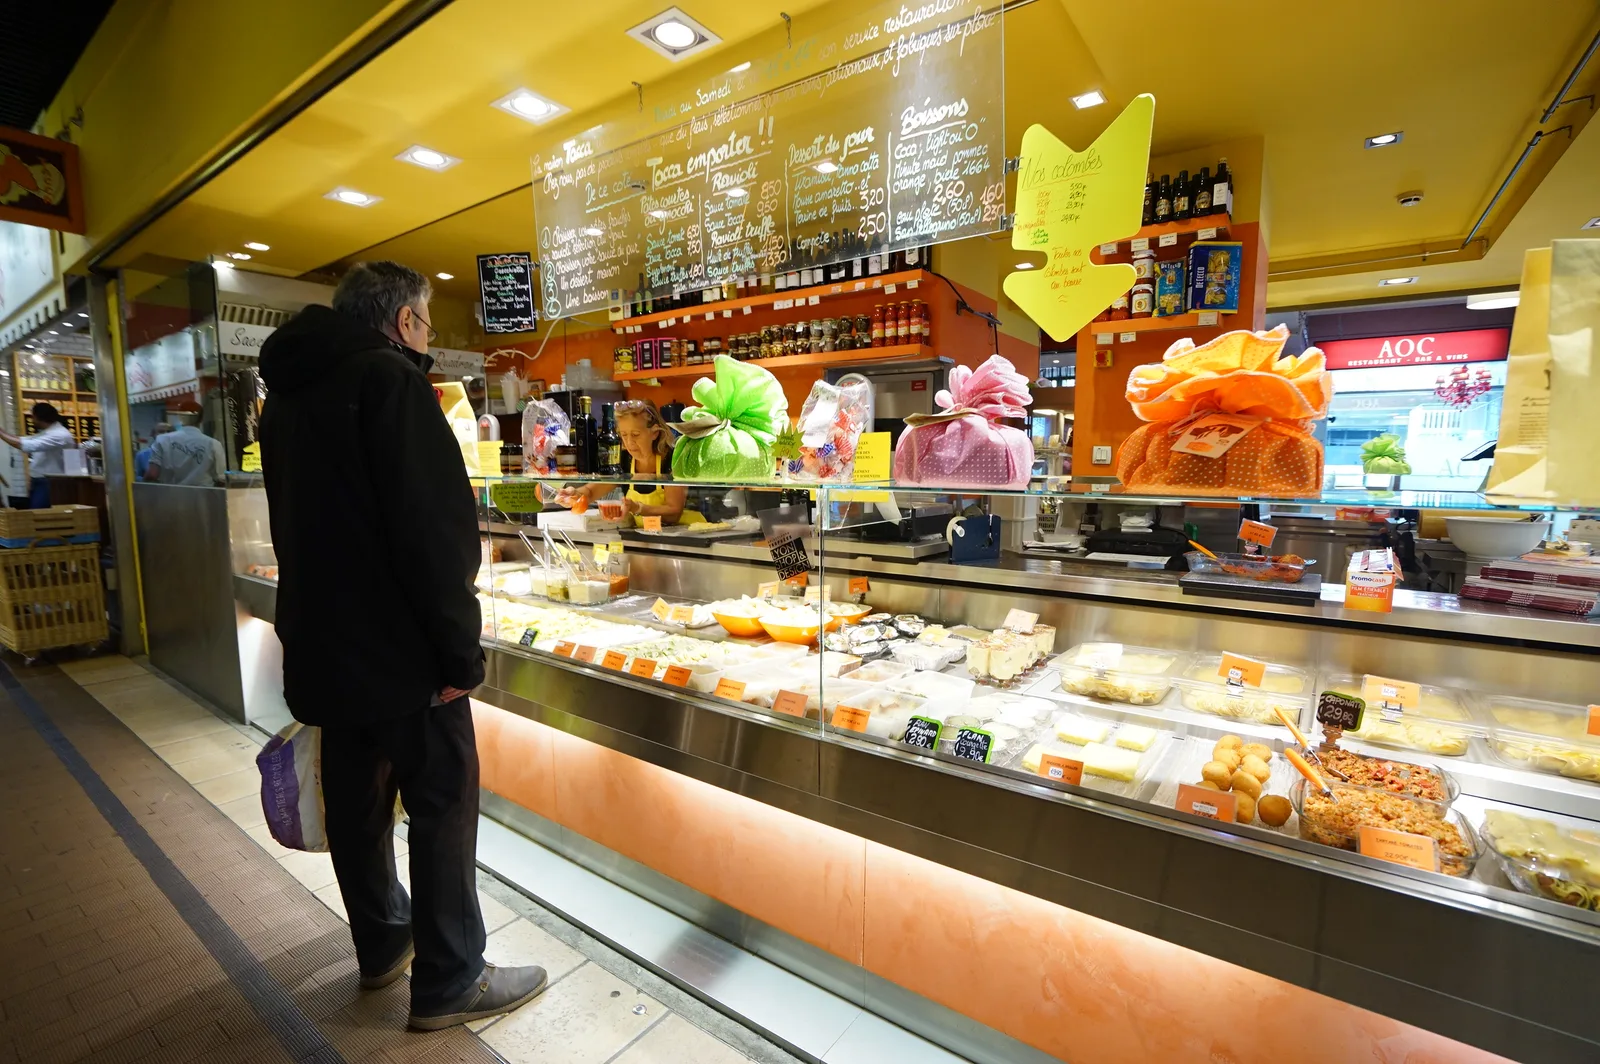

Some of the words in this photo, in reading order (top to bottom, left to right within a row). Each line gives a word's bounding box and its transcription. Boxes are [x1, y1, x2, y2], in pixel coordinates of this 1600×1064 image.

[563, 139, 593, 164] Tocca
[680, 99, 692, 114] au
[696, 78, 732, 107] Samedi
[843, 22, 880, 50] service
[676, 124, 687, 141] du
[884, 40, 895, 63] et
[900, 97, 969, 135] Boissons
[789, 134, 825, 167] Dessert
[825, 133, 840, 155] du
[839, 126, 875, 162] jour
[926, 128, 949, 156] light
[949, 130, 963, 146] ou
[646, 157, 684, 192] Tocca
[687, 130, 754, 183] emporter
[860, 151, 879, 173] cotta
[893, 158, 921, 180] Minute
[922, 150, 948, 170] maid
[962, 157, 991, 176] 1664
[1021, 153, 1046, 189] Nos
[1051, 147, 1103, 180] colombes
[711, 161, 759, 193] Ravioli
[585, 181, 596, 206] De
[598, 184, 609, 199] ce
[792, 190, 813, 209] Mousse
[818, 205, 828, 217] de
[859, 187, 884, 212] 3,20
[933, 180, 965, 206] 2,60
[704, 200, 724, 217] Sauce
[704, 218, 725, 234] Sauce
[725, 212, 745, 226] Tocca
[858, 211, 887, 241] 2,50
[646, 232, 666, 252] Sauce
[664, 245, 683, 260] Tocca
[570, 270, 593, 288] dessert
[596, 262, 620, 280] maison
[707, 265, 729, 278] Sauce
[565, 293, 580, 309] Une
[583, 287, 609, 304] boisson
[1377, 337, 1435, 358] AOC
[1348, 358, 1402, 366] RESTAURANT
[771, 540, 795, 559] LYON
[775, 553, 797, 569] SHOP
[799, 550, 806, 559] &
[779, 561, 810, 580] DESIGN
[1351, 575, 1387, 583] Promocash
[960, 740, 988, 751] courgette
[962, 730, 984, 743] FLAN
